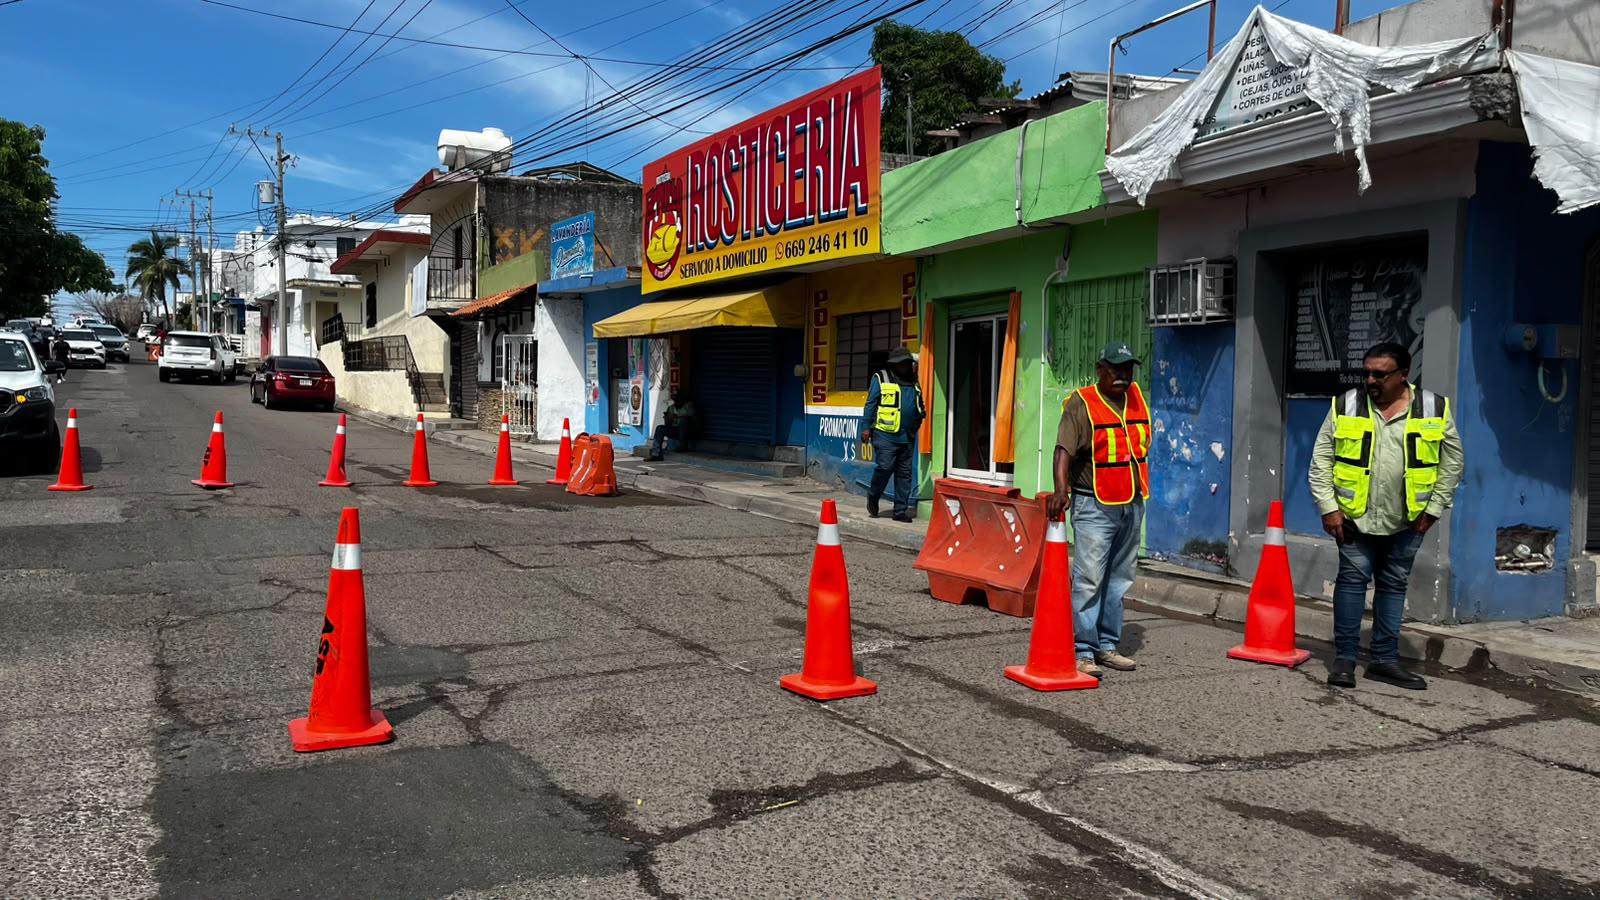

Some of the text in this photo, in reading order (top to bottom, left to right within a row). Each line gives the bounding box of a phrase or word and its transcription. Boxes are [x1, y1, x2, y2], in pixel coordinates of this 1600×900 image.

[1241, 64, 1289, 86] DELINEADOS
[1272, 74, 1292, 88] OJOS
[1238, 94, 1271, 110] CORTES
[1272, 90, 1283, 101] DE
[686, 84, 869, 254] ROSTICERIA
[785, 226, 868, 259] 669 246 41 10
[679, 258, 713, 279] SERVICIO
[715, 256, 721, 272] A
[722, 246, 767, 271] DOMICILIO
[902, 271, 918, 349] POL
[813, 290, 829, 404] POLLOS
